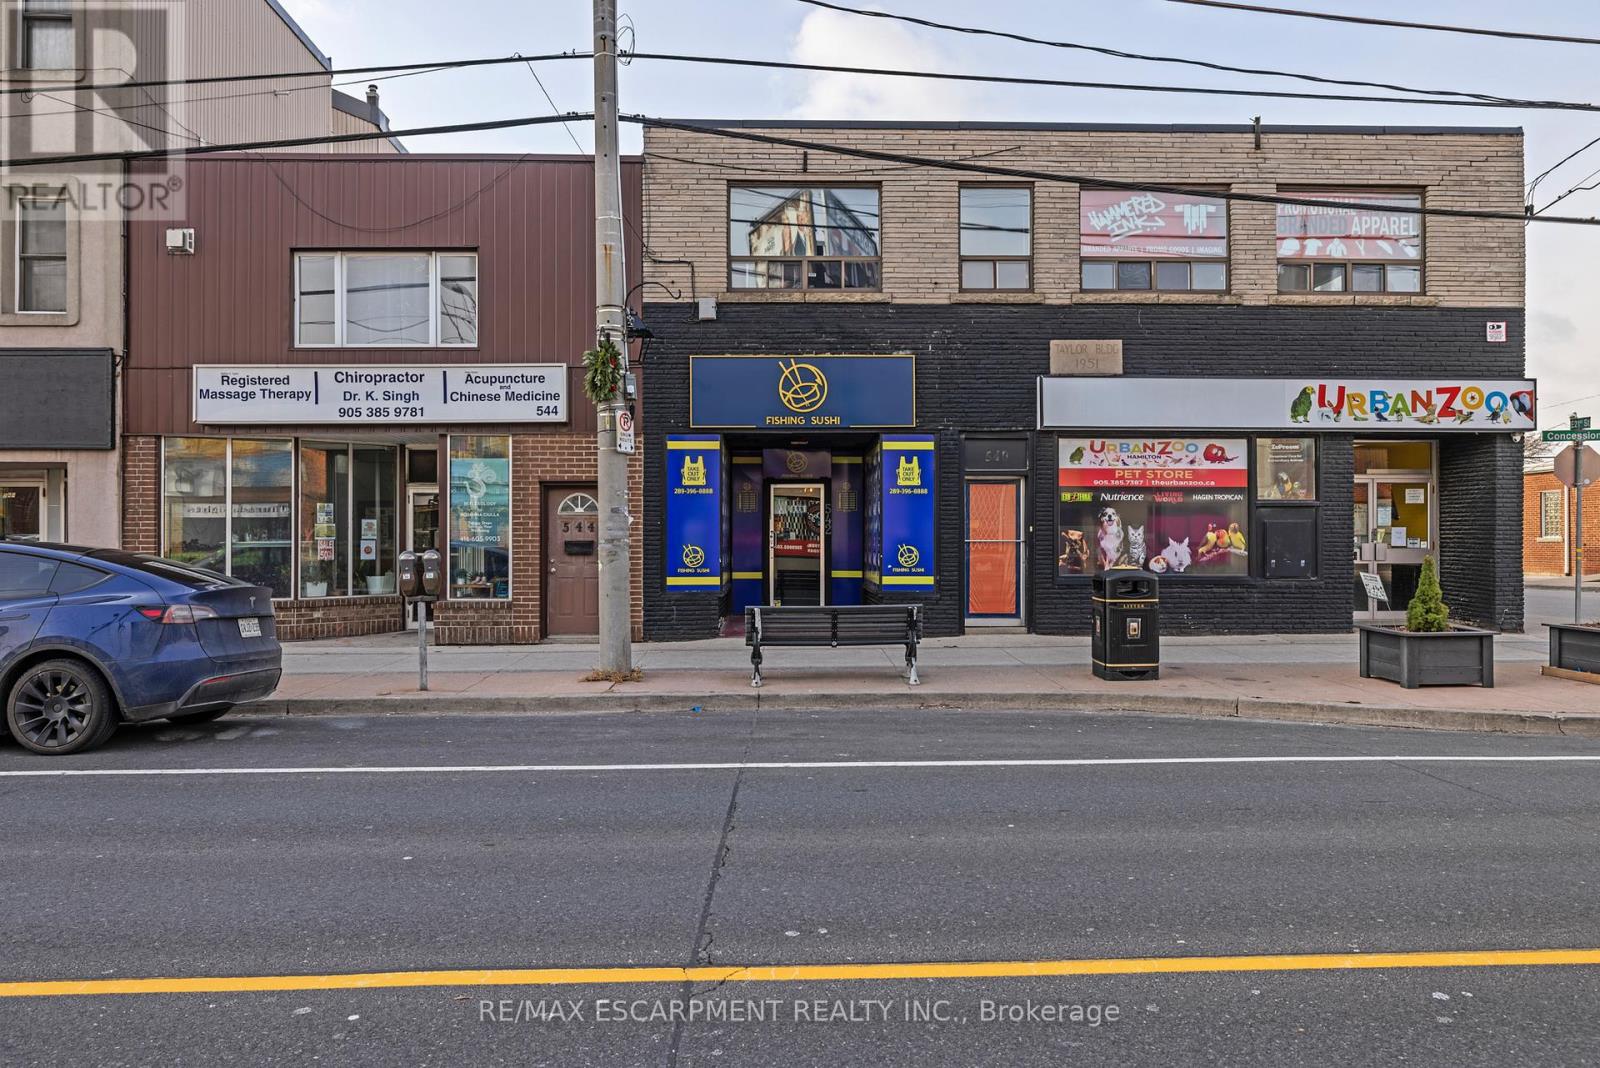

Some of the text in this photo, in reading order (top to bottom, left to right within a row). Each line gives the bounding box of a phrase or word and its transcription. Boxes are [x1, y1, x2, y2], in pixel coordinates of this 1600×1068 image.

[1088, 193, 1166, 231] HAMMERED
[1351, 216, 1418, 235] APPAREL
[1055, 344, 1118, 354] TAYLOR BLDG
[1075, 359, 1100, 369] 1951
[221, 375, 290, 388] Registered
[334, 370, 425, 386] Chiropractor
[464, 373, 546, 386] Acupuncture
[199, 388, 312, 402] Massage Therapy
[343, 390, 420, 403] Dr. K. Singh
[449, 391, 561, 402] Chinese Medicine
[1317, 384, 1509, 418] URBANZOO
[338, 407, 425, 418] 905 385 9781
[536, 405, 558, 416] 544
[765, 416, 840, 425] FISHING SUSHI
[1547, 431, 1600, 441] Concession
[1089, 440, 1198, 455] URBANZOO
[1115, 470, 1193, 479] PET STORE
[1100, 491, 1144, 501] Nutrience
[562, 522, 595, 533] 544
